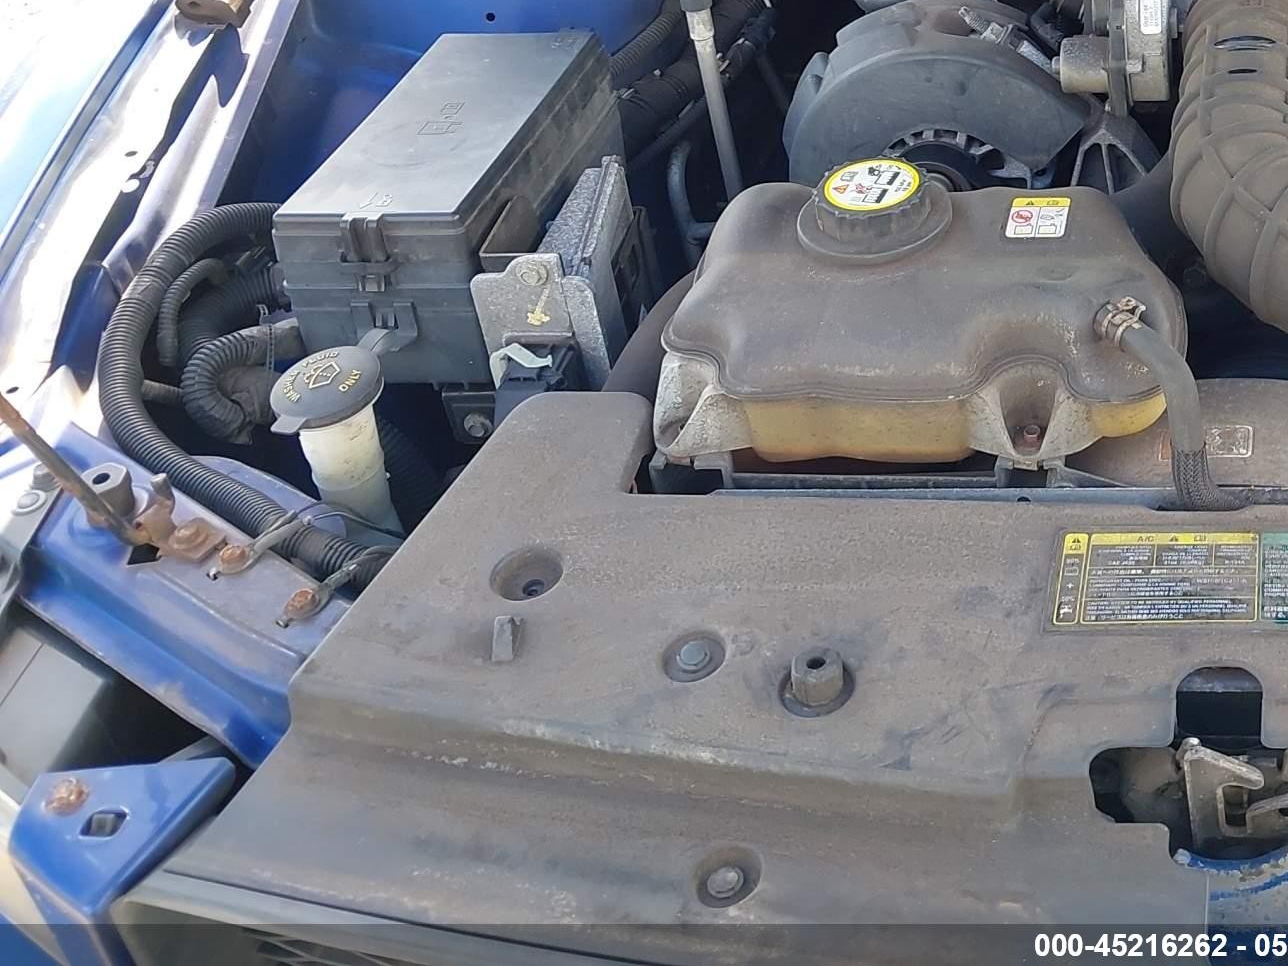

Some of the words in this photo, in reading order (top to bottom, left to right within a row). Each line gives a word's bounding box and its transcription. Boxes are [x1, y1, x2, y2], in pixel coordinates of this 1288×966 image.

[302, 351, 339, 368] FLUID
[339, 369, 362, 392] ONLY
[1136, 535, 1155, 543] A/C
